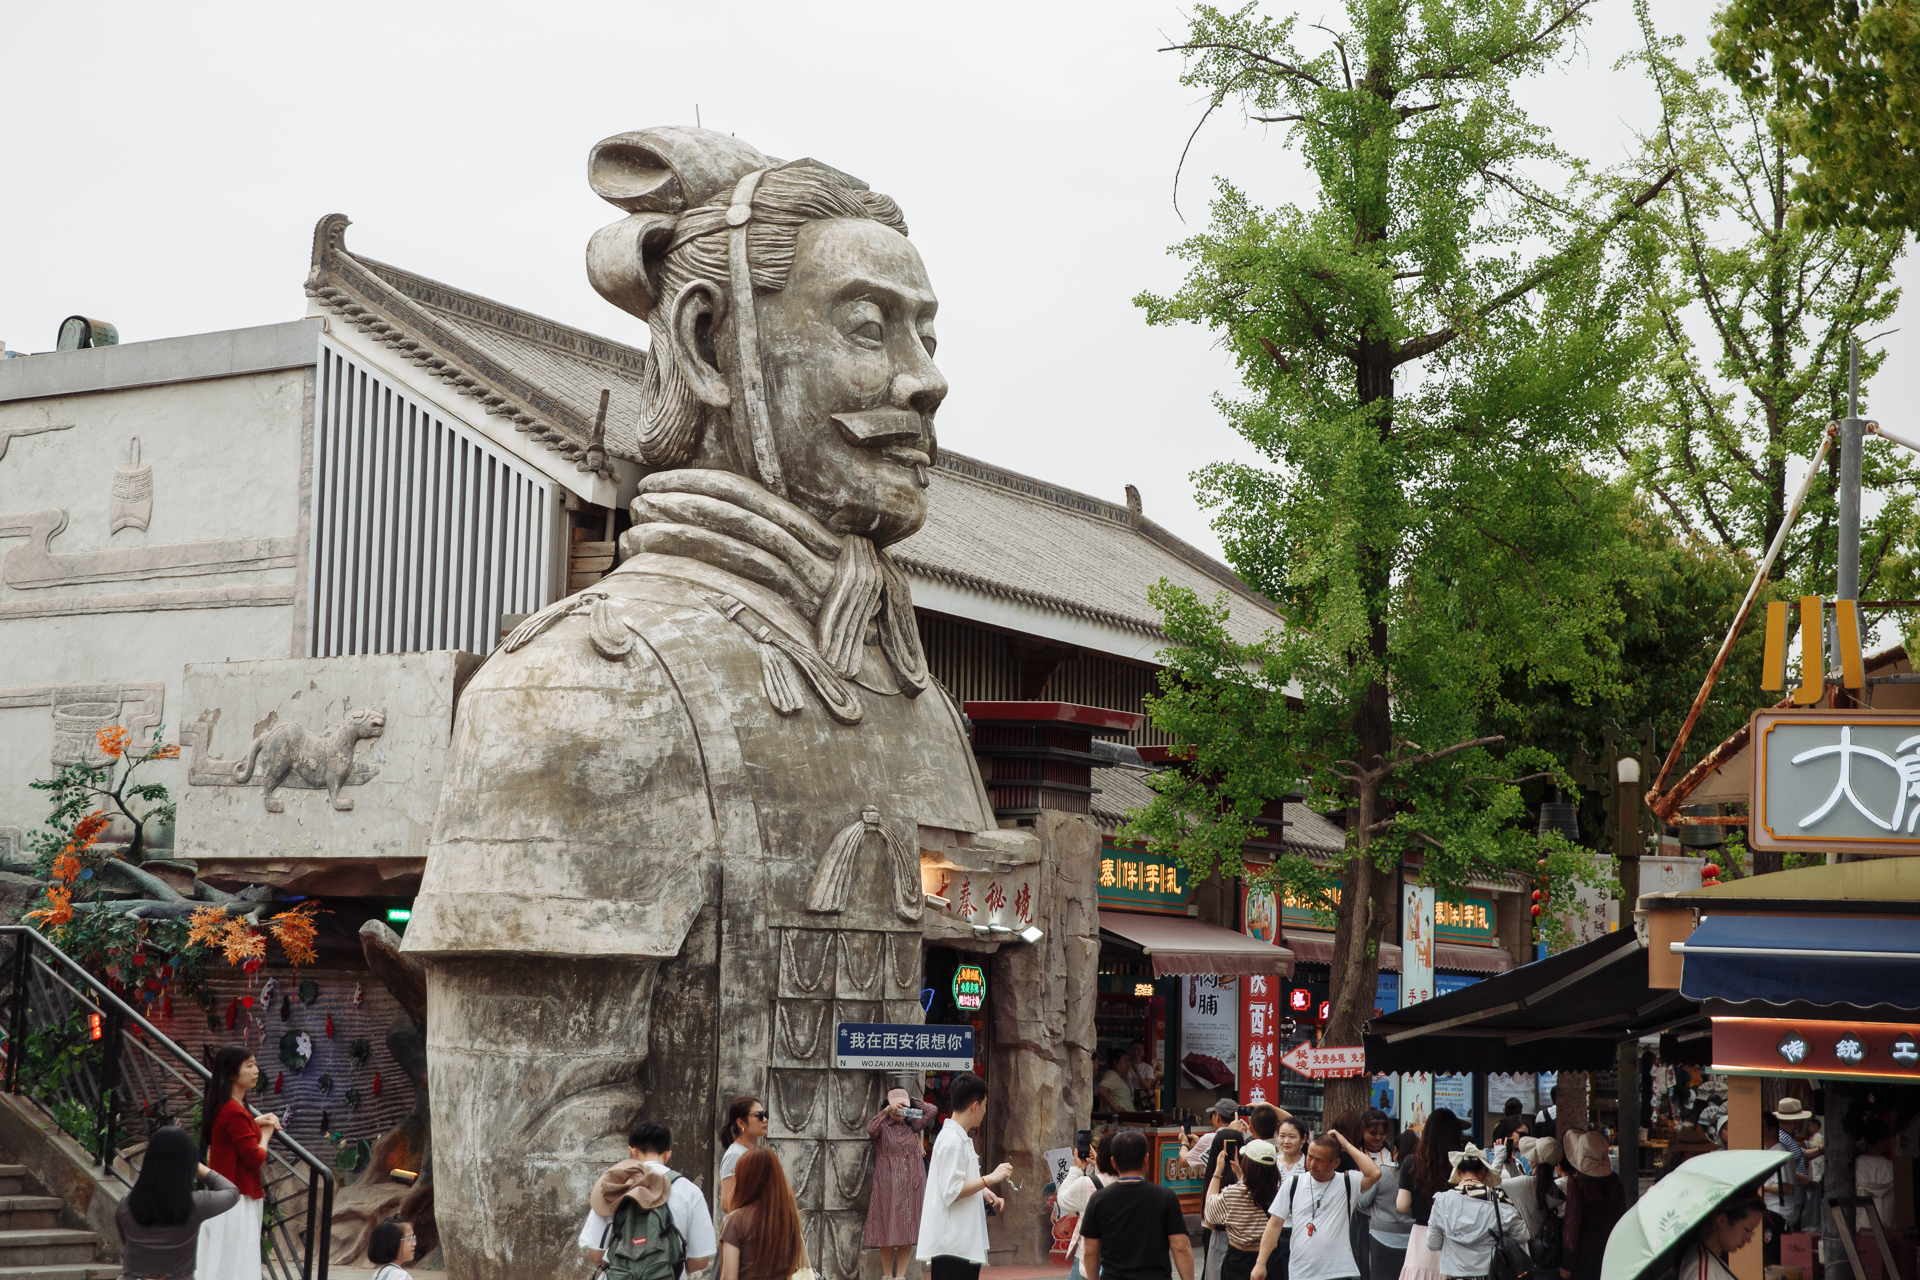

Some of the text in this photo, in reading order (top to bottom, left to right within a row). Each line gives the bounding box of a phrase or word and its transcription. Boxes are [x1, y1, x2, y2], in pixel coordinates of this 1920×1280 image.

[840, 1028, 848, 1037] 北
[964, 1031, 972, 1040] 南
[849, 1032, 963, 1051] 我在西安很想你
[840, 1059, 846, 1067] N
[1295, 1049, 1309, 1070] 秘境
